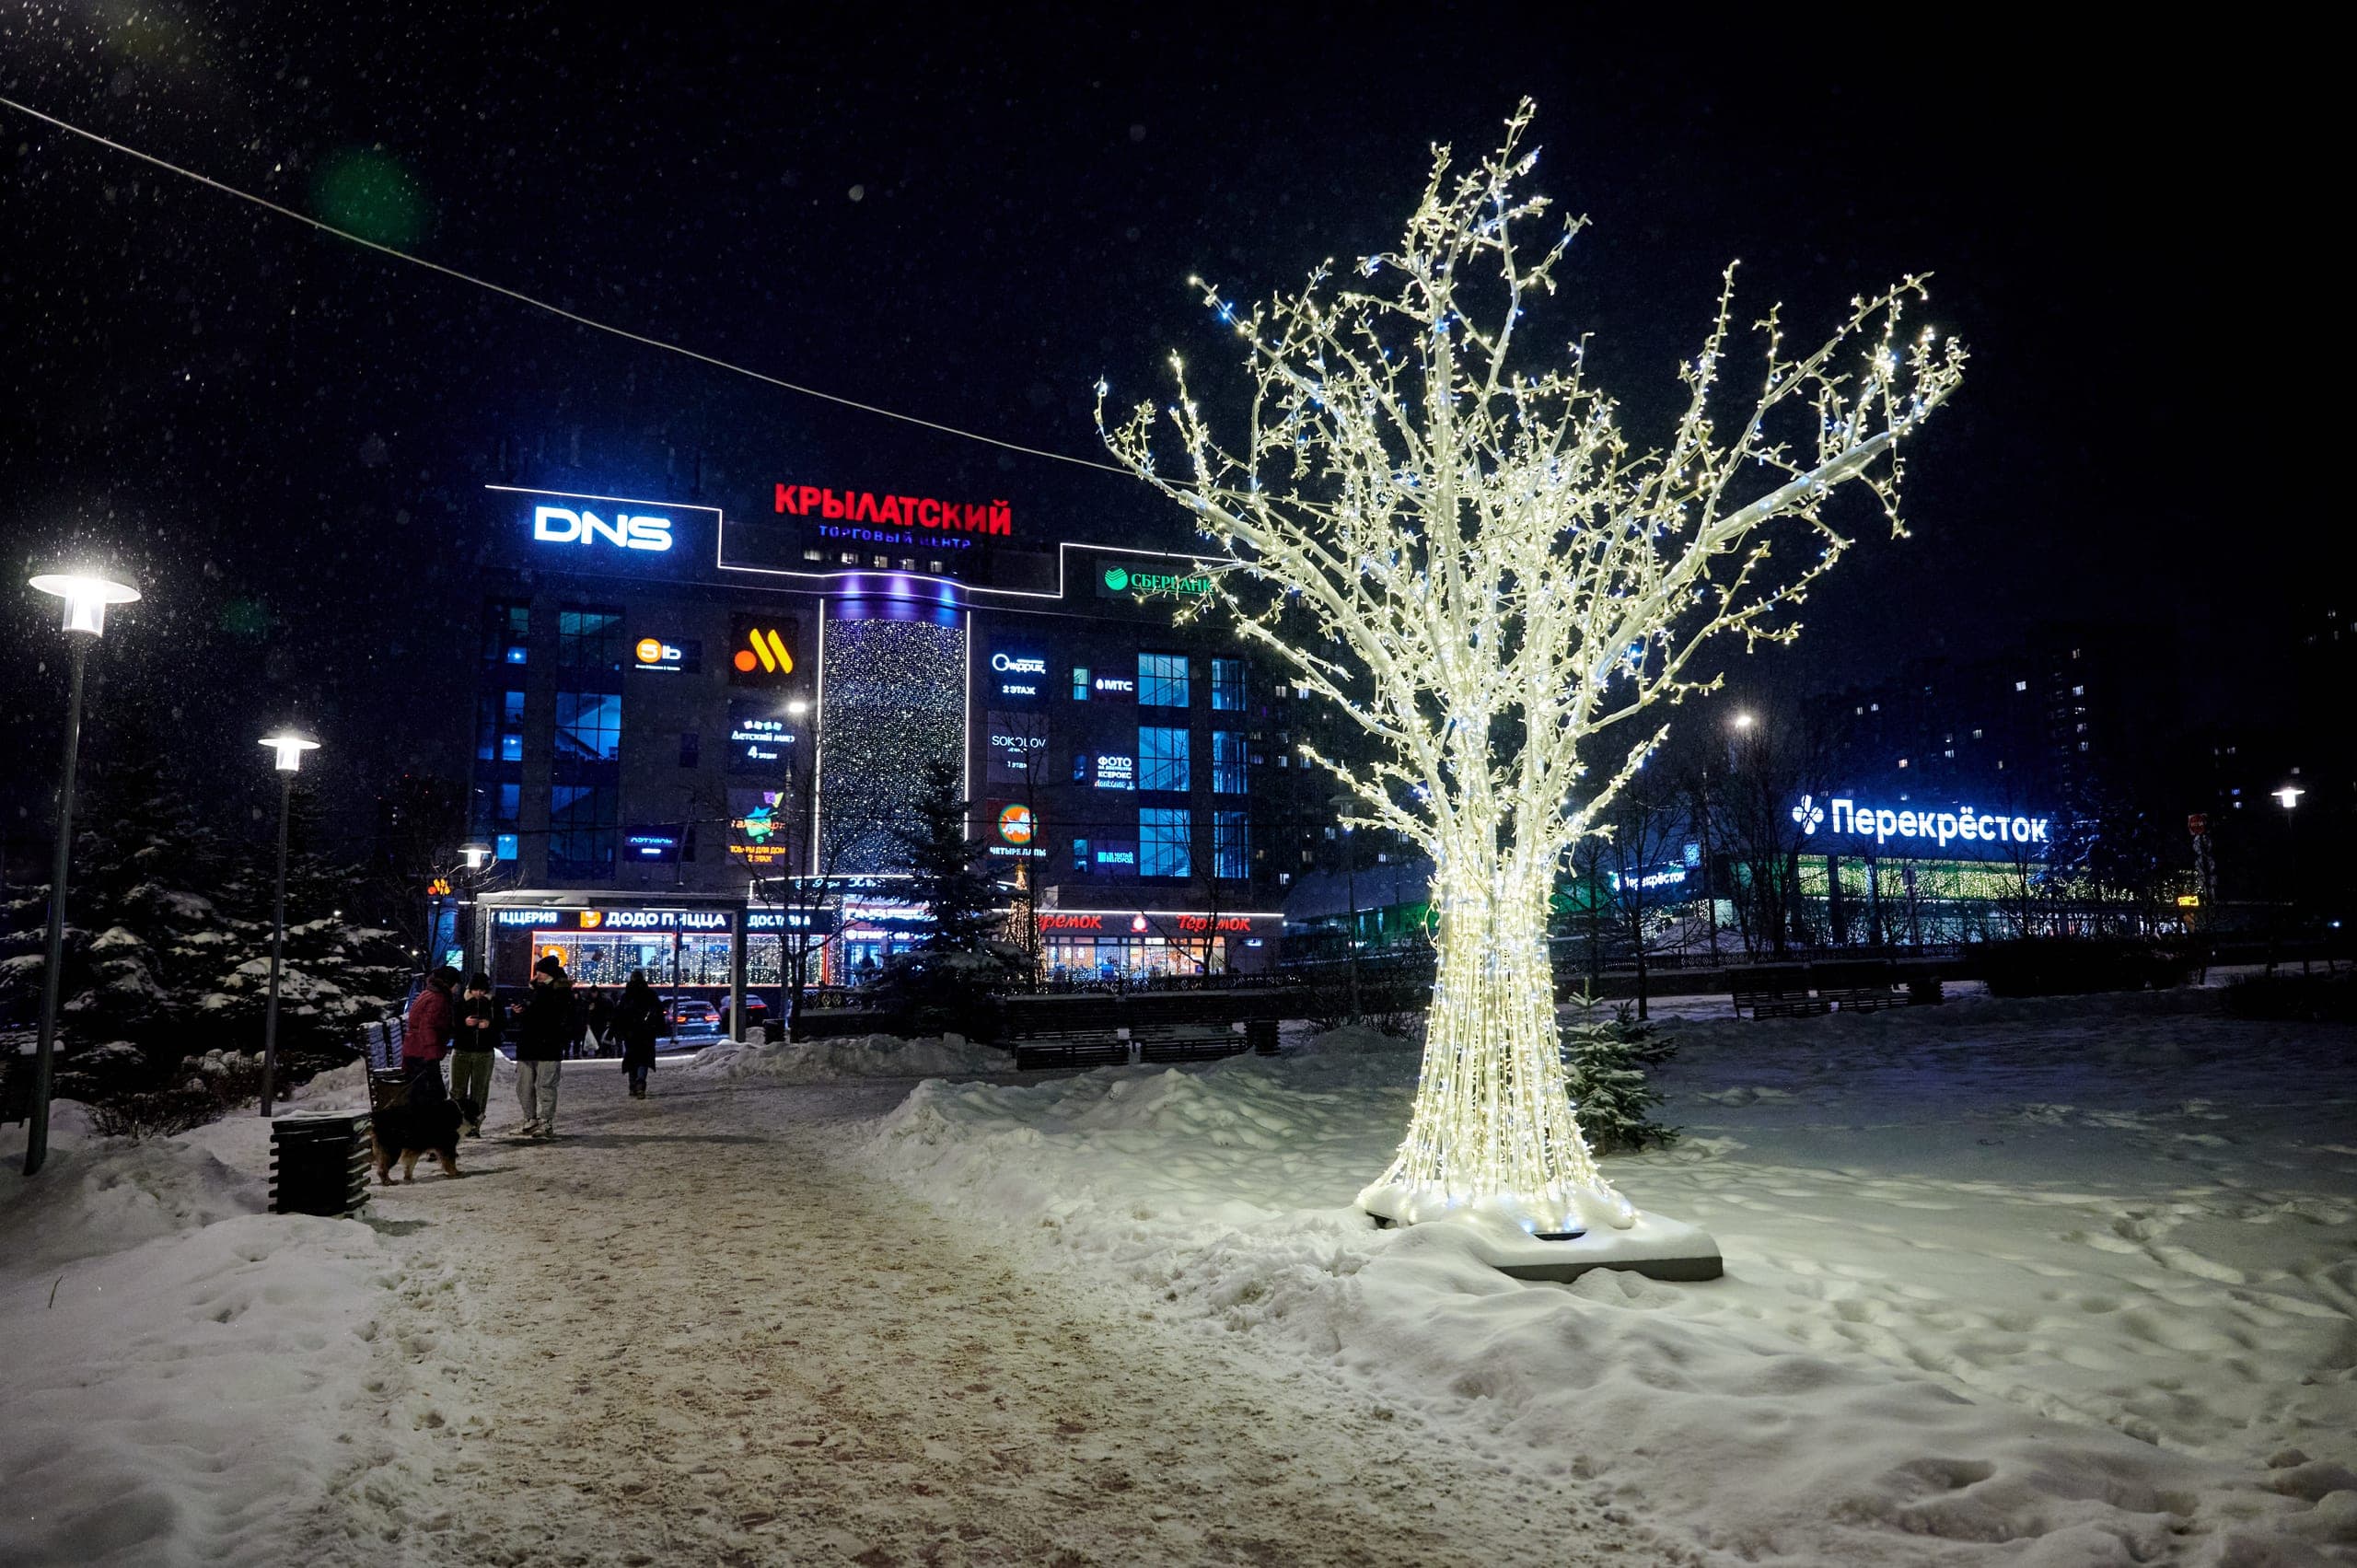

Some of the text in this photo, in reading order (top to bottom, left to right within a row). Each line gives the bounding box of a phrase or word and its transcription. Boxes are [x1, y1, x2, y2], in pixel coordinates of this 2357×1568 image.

[775, 483, 1011, 536] КРЫЛАТСКИЙ
[534, 505, 673, 552] DNS
[819, 525, 912, 544] ТОРГОВЫЙ
[1131, 573, 1213, 593] СБЕРБАНК
[1003, 685, 1036, 695] 2 ЭТАЖ
[1105, 679, 1132, 691] МТС
[992, 736, 1046, 749] SOKOLOV
[748, 745, 758, 759] 4
[1097, 756, 1132, 767] ФОТО
[1097, 771, 1132, 779] КСЕРОКС
[1831, 799, 2049, 846] Перекрёсток
[990, 846, 1021, 855] ЧЕТЫРЕ
[606, 912, 659, 927] ДОДО
